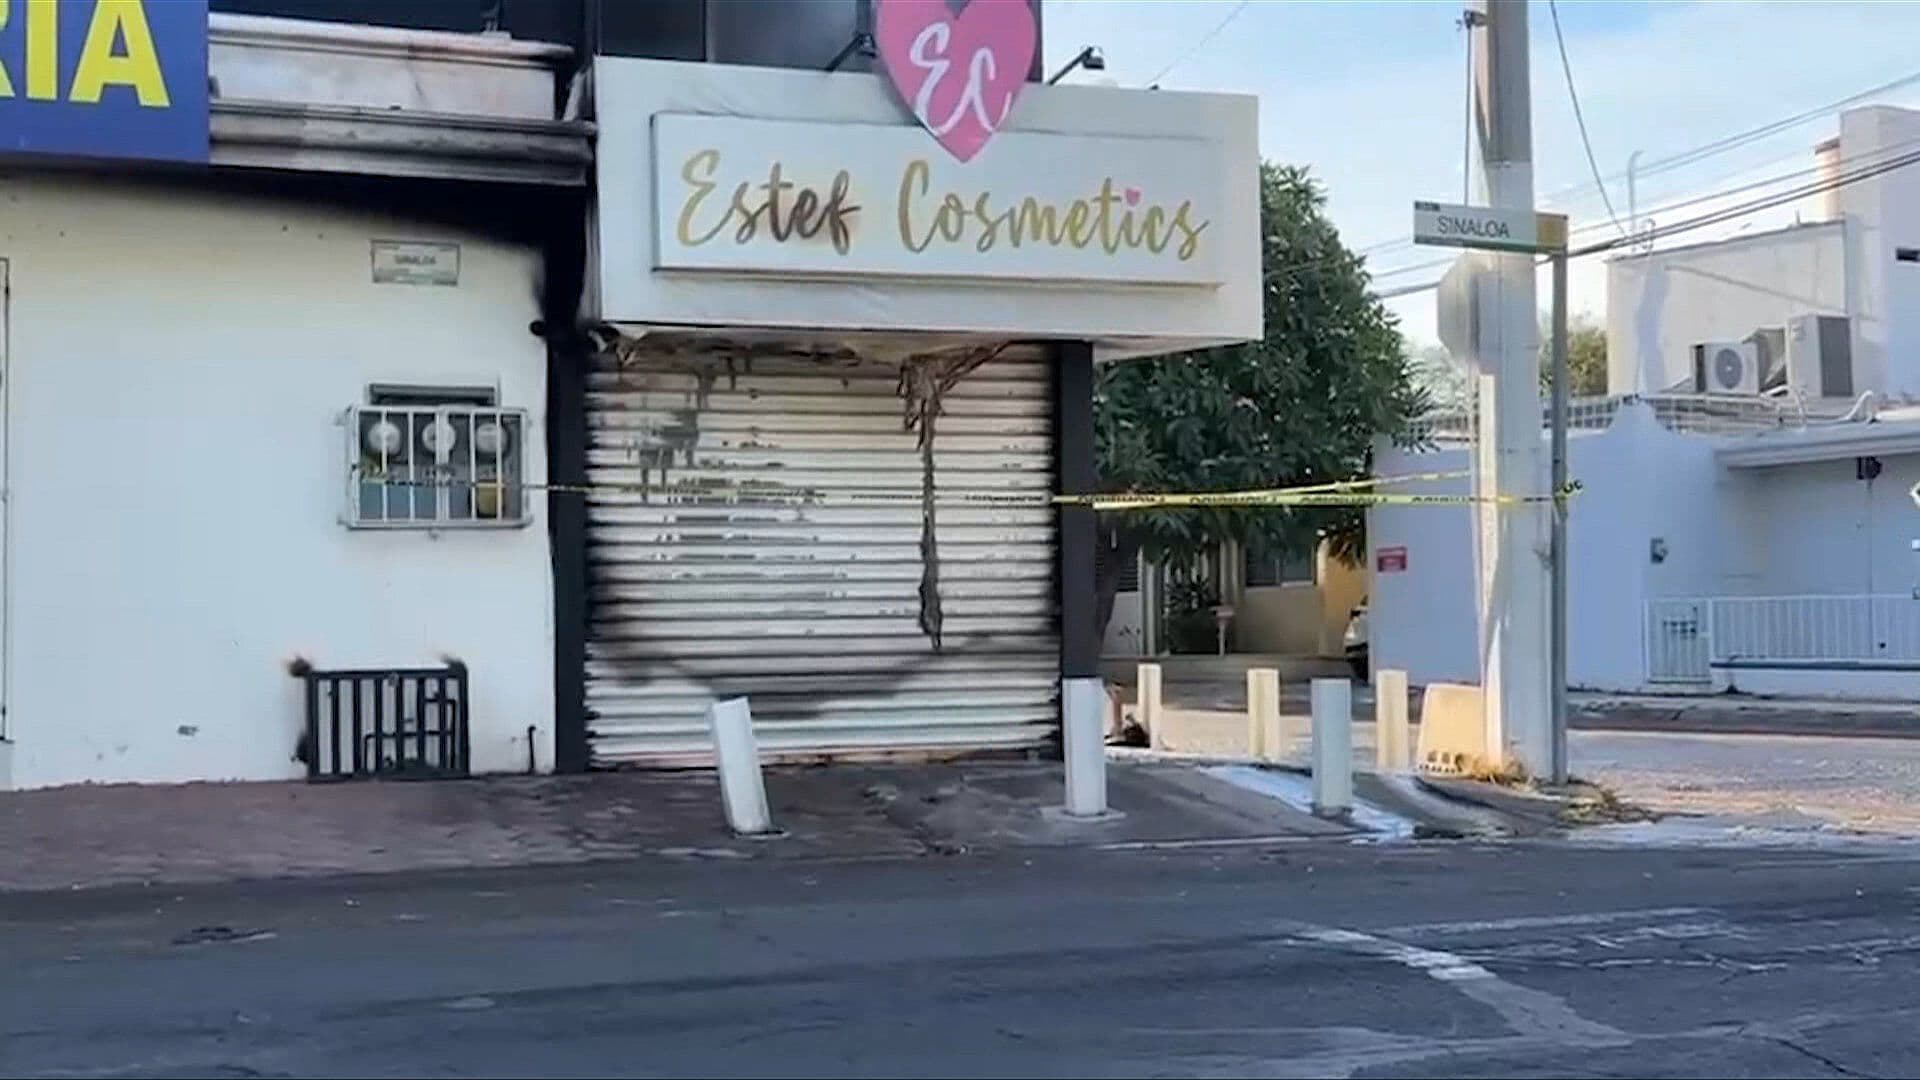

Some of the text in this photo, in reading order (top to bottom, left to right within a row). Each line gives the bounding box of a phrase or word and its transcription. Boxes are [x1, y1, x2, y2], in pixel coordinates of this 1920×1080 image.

[0, 0, 171, 108] IA
[909, 20, 1013, 137] EC
[677, 149, 1211, 261] Estef Cosmetics
[1437, 214, 1511, 239] SINALOA
